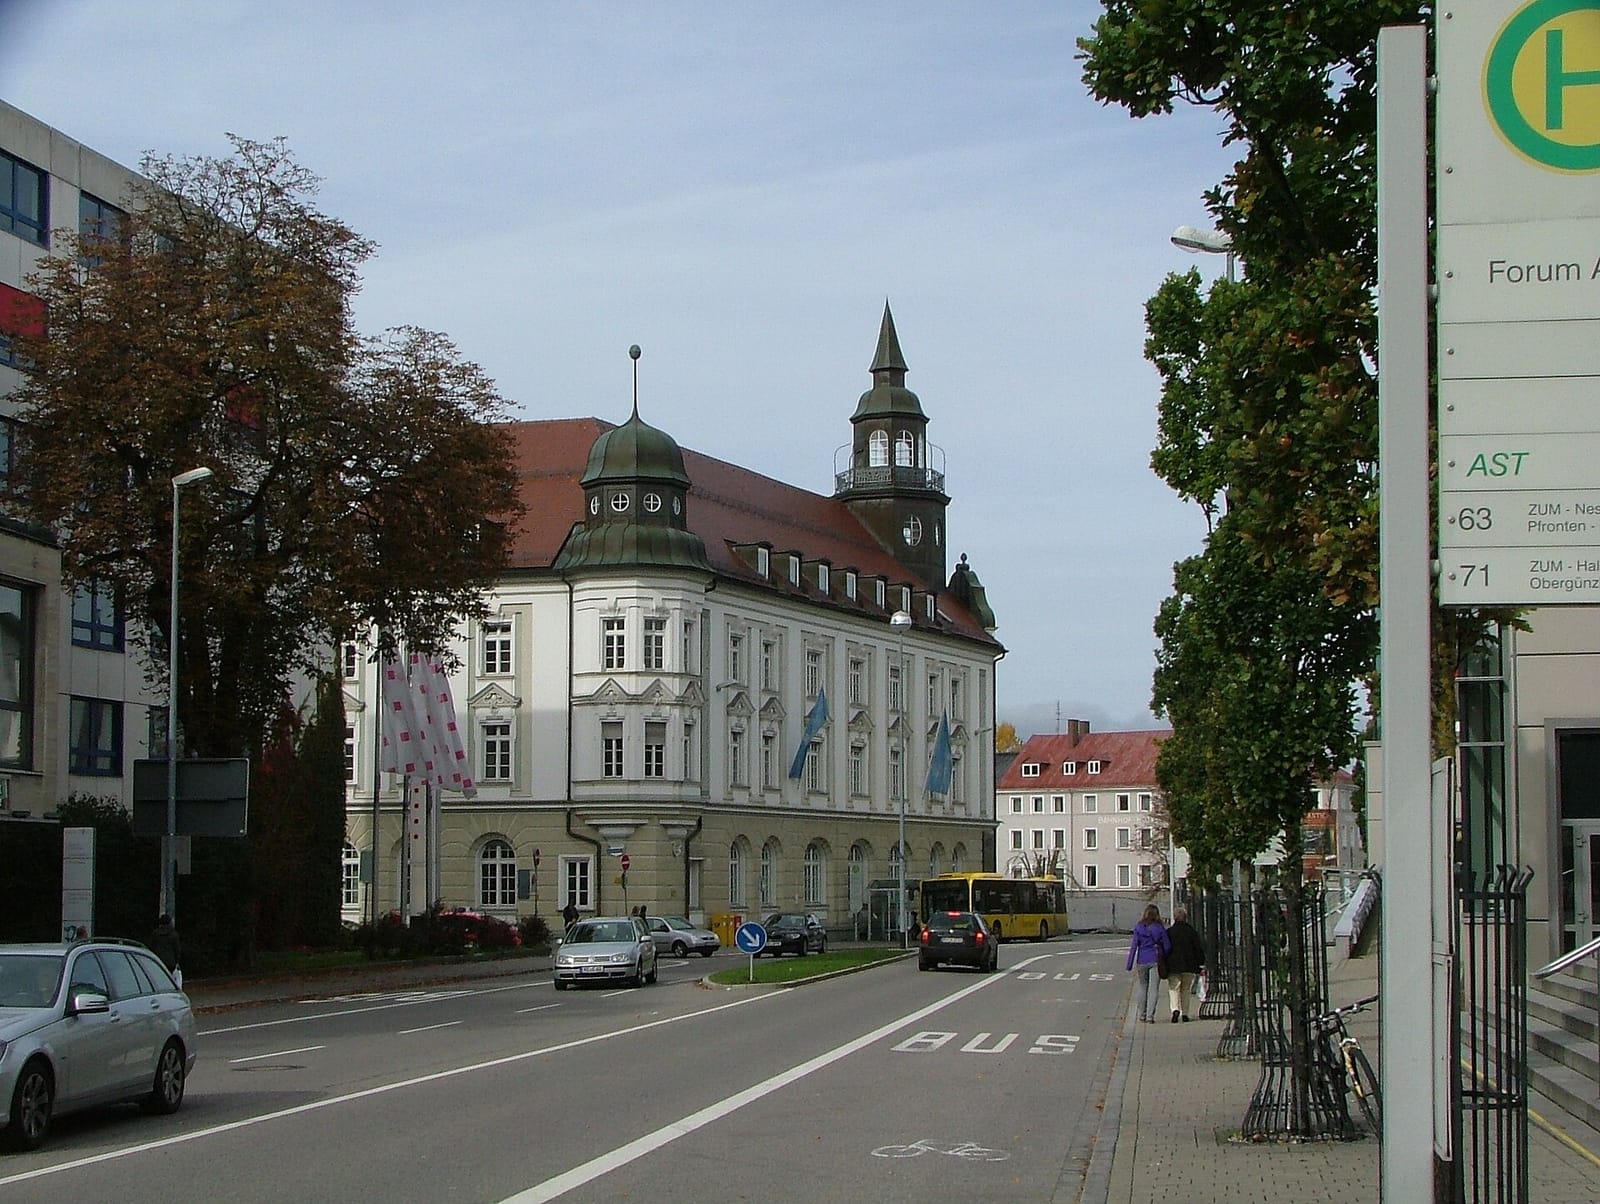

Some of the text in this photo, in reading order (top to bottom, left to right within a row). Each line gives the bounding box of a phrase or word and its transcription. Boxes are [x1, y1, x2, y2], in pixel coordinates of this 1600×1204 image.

[1546, 29, 1600, 130] H
[1489, 260, 1580, 283] Forum
[1466, 452, 1529, 477] AST
[1458, 507, 1492, 530] 63
[1528, 504, 1561, 516] ZUM
[1528, 520, 1586, 532] Pfronten
[1460, 565, 1489, 587] 71
[1530, 560, 1563, 573] ZUM
[1577, 560, 1600, 572] Hal
[1530, 577, 1600, 592] Obergünz
[891, 1031, 1081, 1054] BUS
